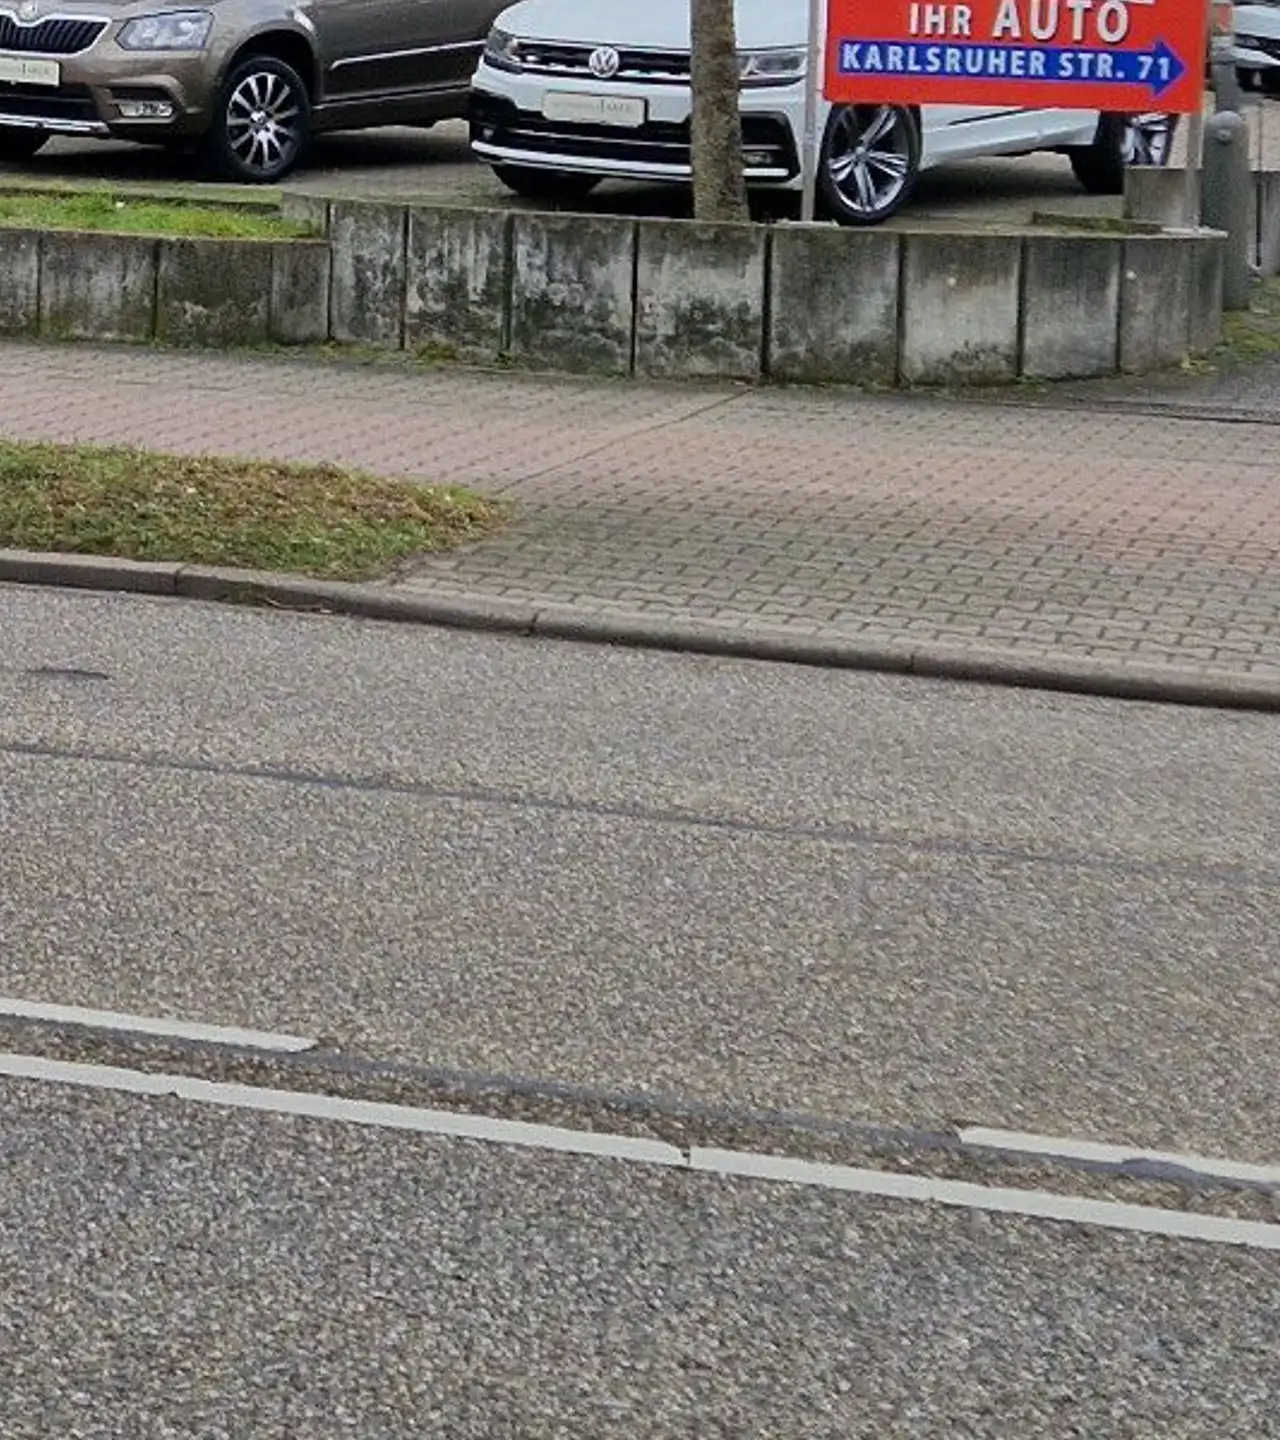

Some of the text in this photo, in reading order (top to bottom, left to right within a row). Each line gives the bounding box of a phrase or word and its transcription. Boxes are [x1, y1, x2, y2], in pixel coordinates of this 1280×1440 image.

[908, 2, 972, 37] IHR
[842, 43, 1171, 80] KARLSRUHER STR. 71
